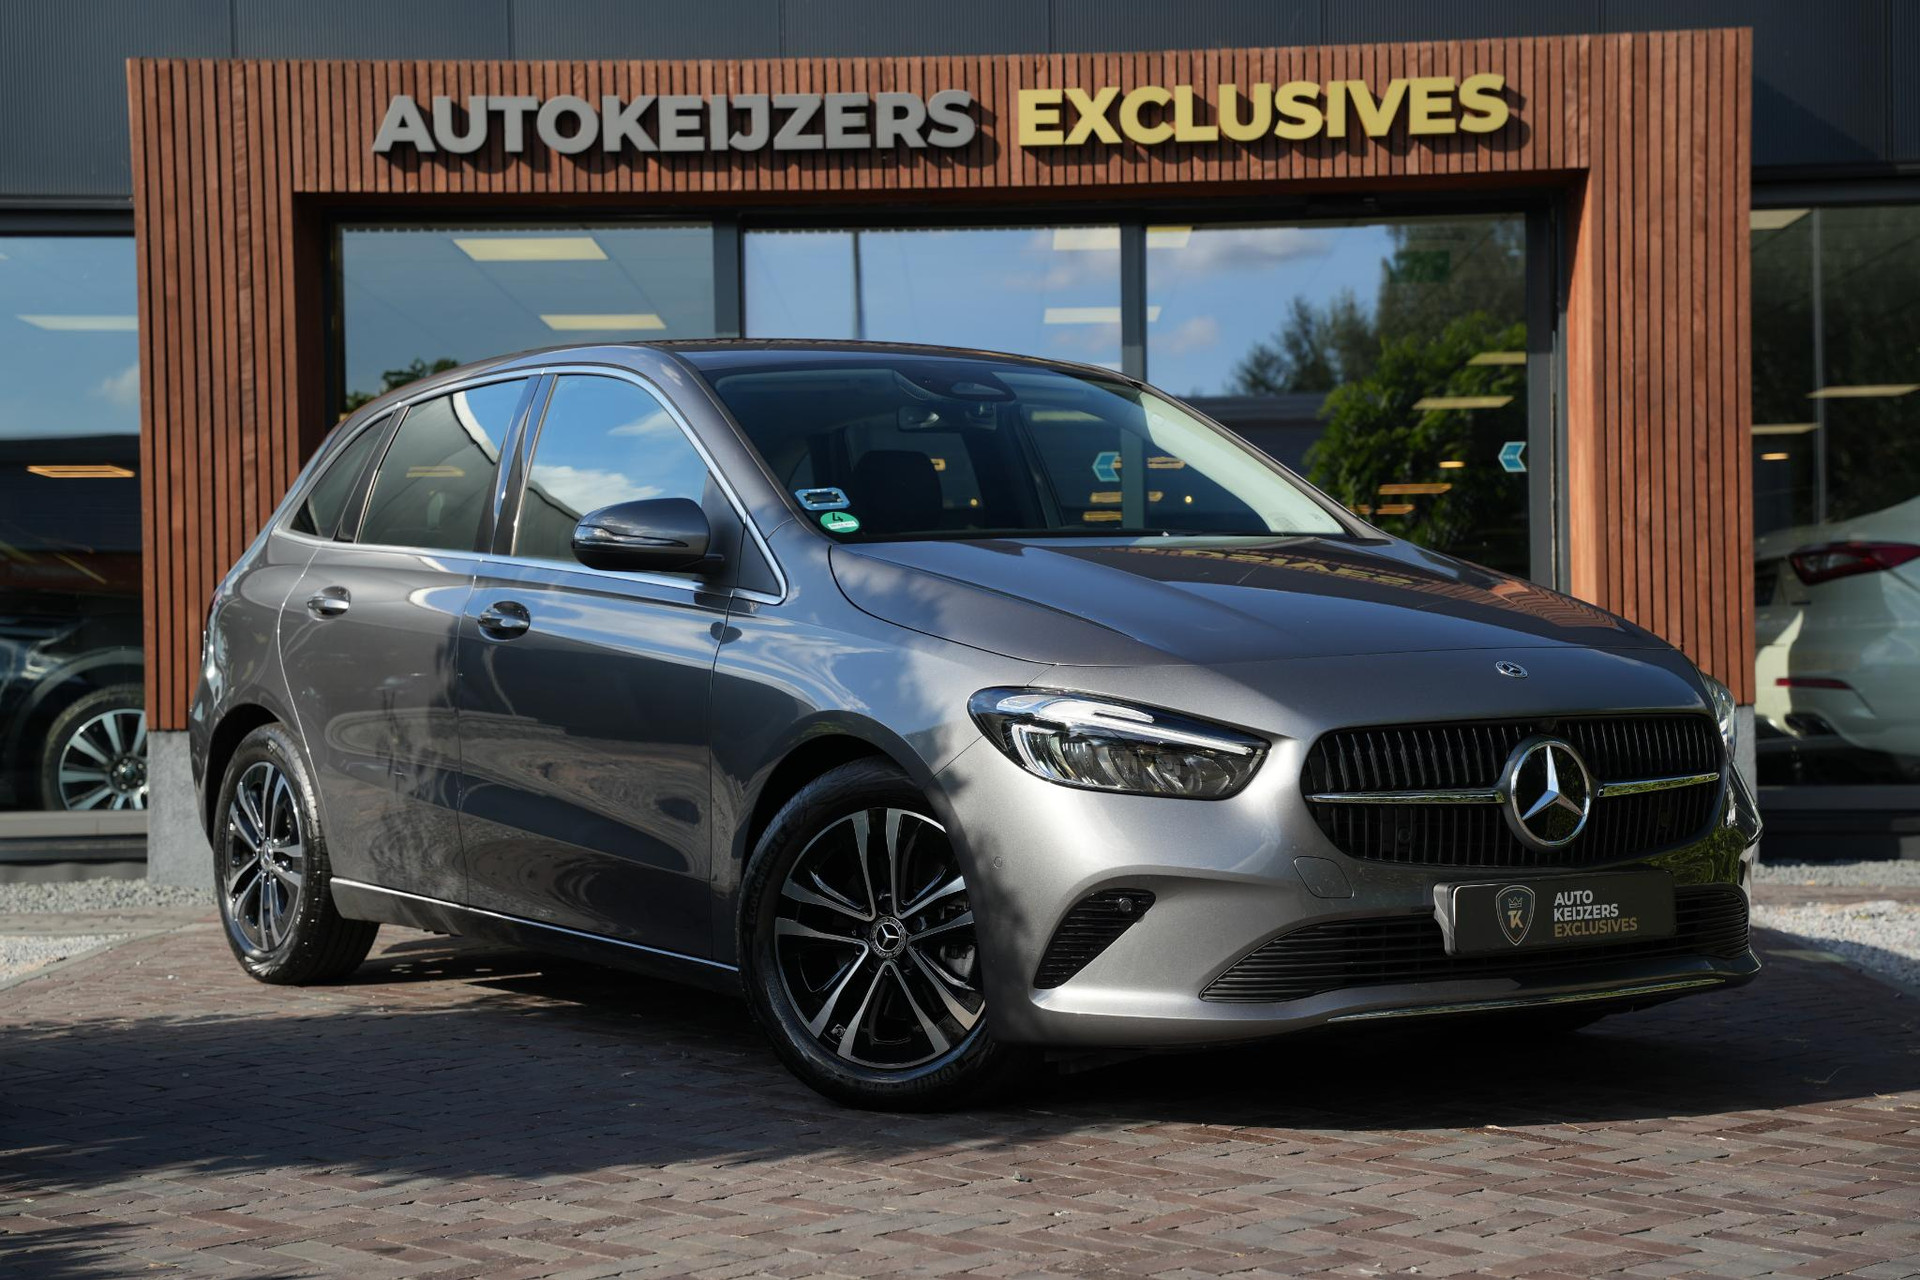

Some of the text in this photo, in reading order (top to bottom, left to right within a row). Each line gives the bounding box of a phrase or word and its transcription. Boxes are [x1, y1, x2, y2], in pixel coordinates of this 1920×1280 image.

[372, 73, 1511, 154] AUTOKEIJZERS EXCLUSIVES
[1554, 890, 1594, 907] AUTO
[1553, 903, 1619, 922] KEIJZERS
[1554, 917, 1638, 938] EXCLUSIVES
